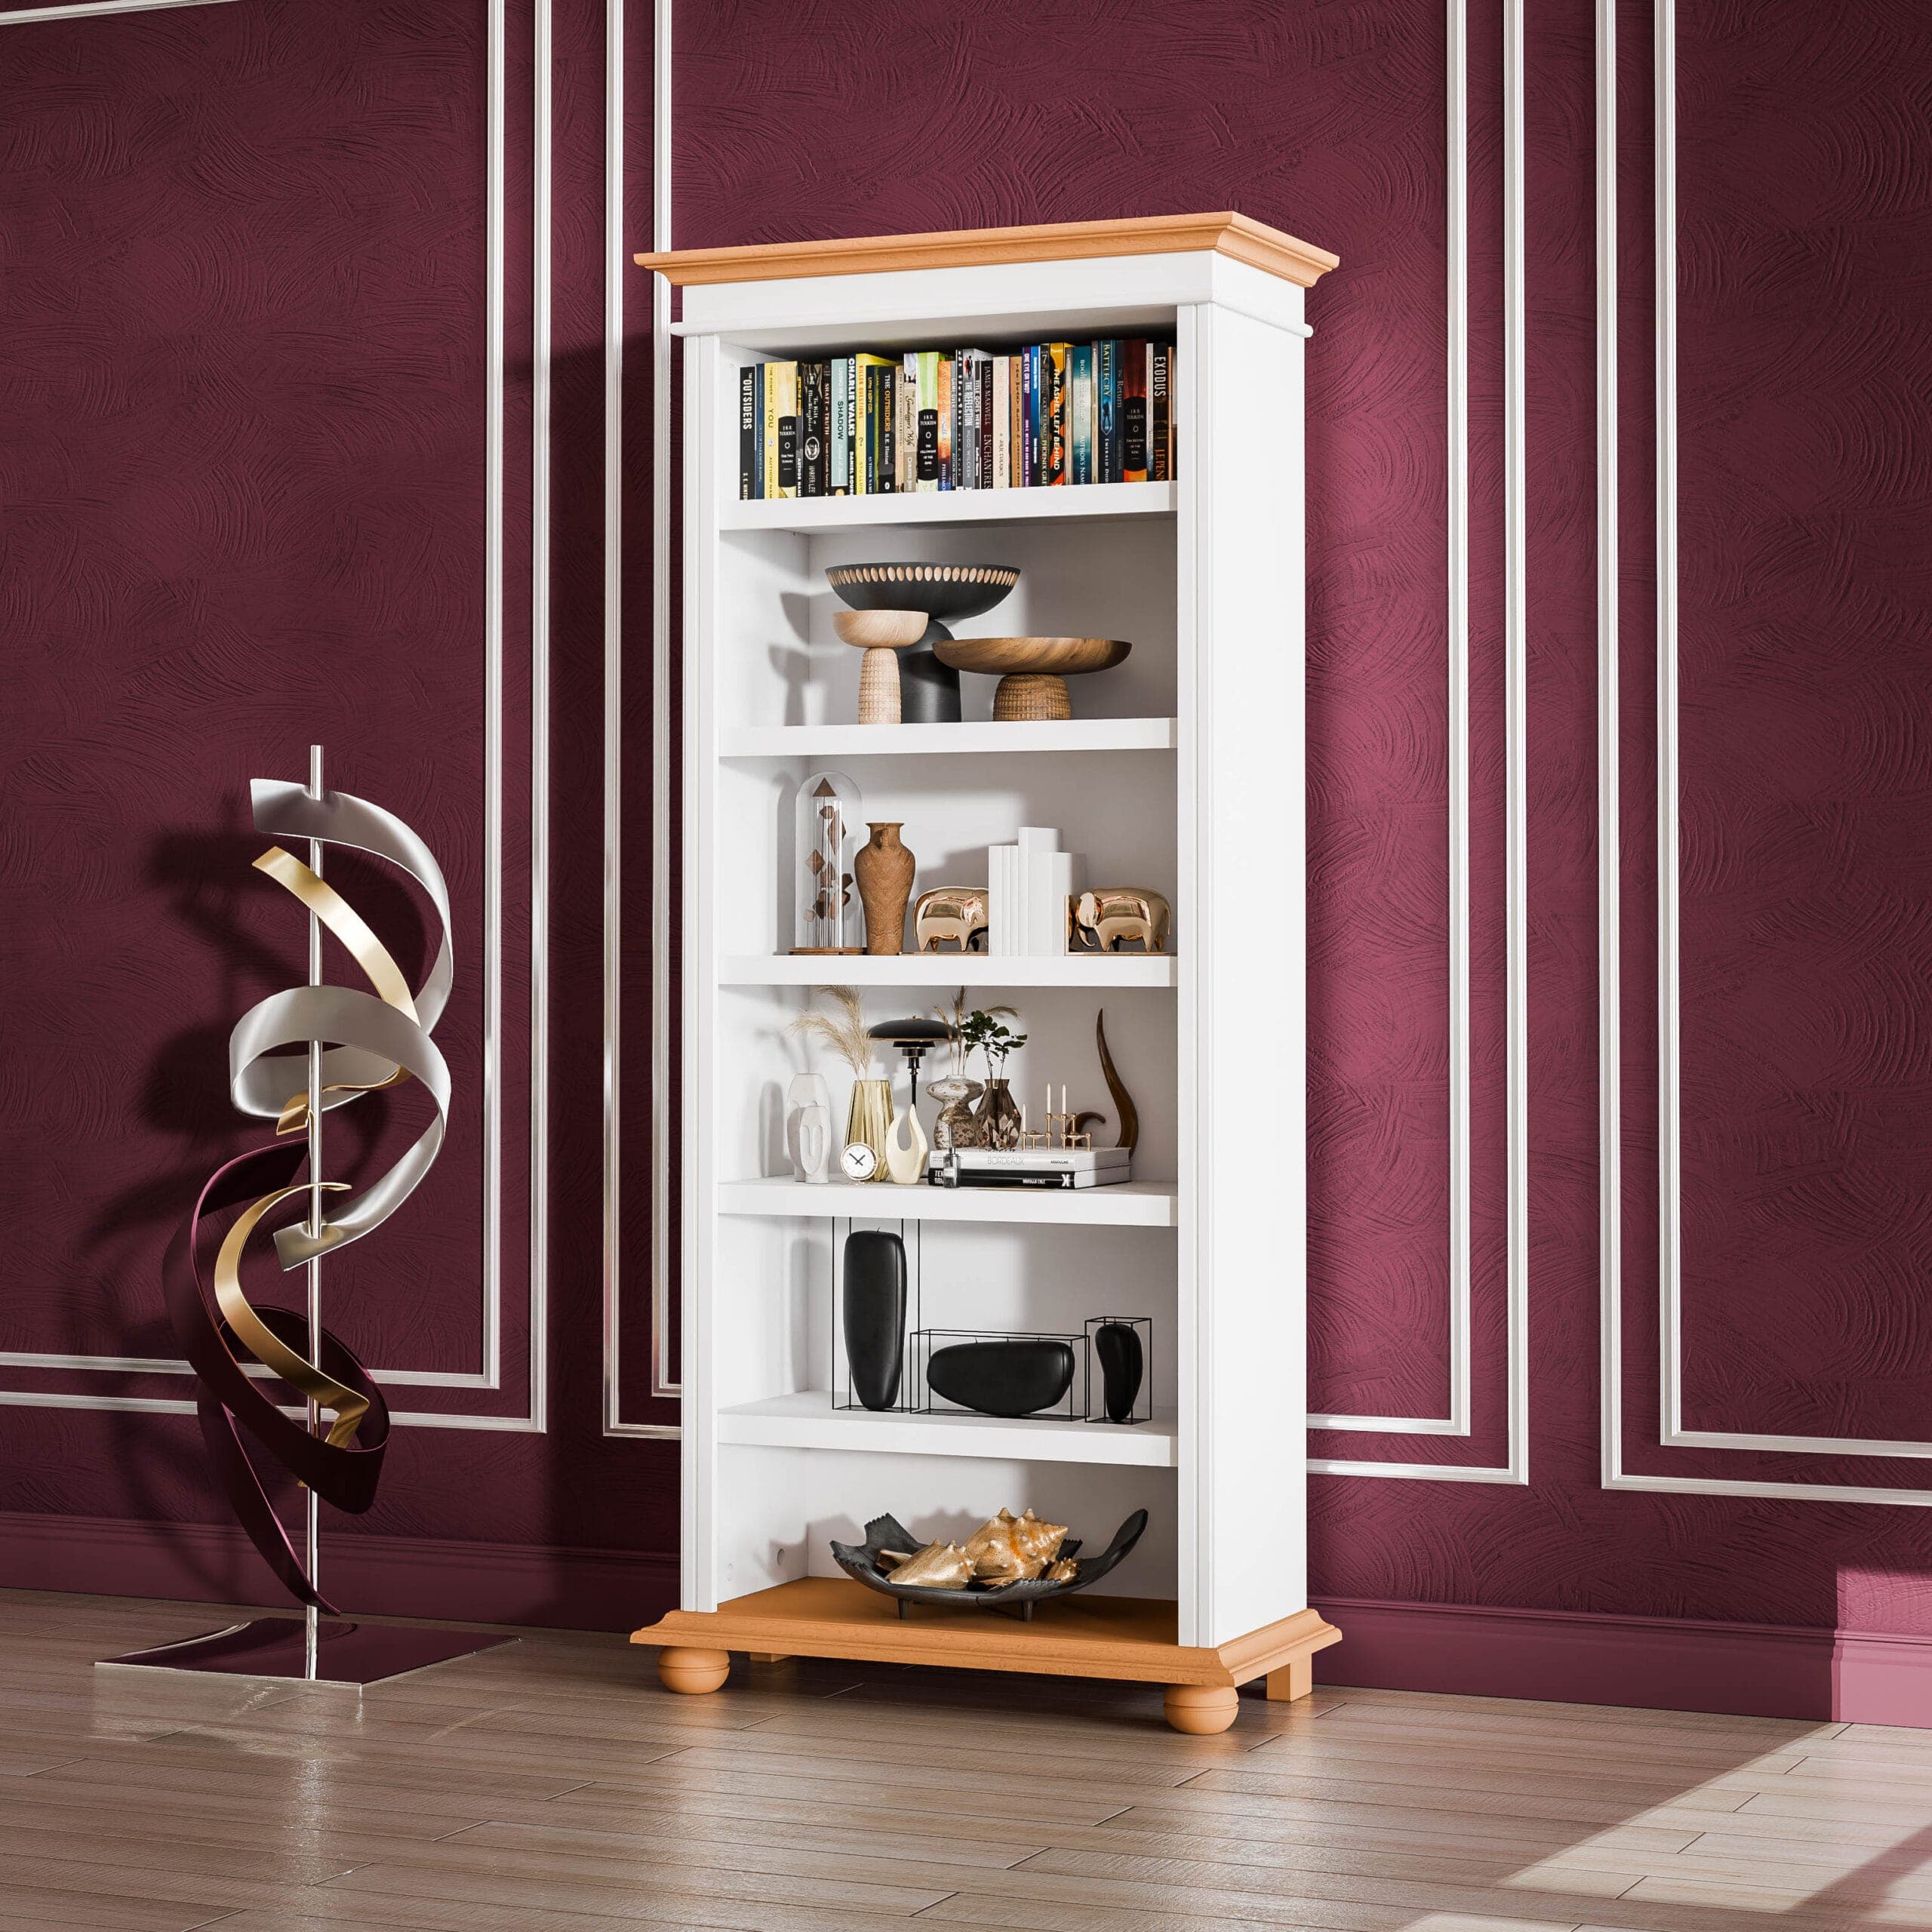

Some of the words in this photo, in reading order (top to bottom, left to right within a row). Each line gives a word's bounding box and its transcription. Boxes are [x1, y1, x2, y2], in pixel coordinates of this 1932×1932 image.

[964, 381, 973, 391] THE
[1103, 344, 1111, 396] BATTLECRY
[1154, 357, 1166, 396] EXODUS
[743, 380, 753, 429] OUTSIDERS
[964, 392, 974, 426] REFLECTION
[987, 1156, 1024, 1165] BORDEAUX
